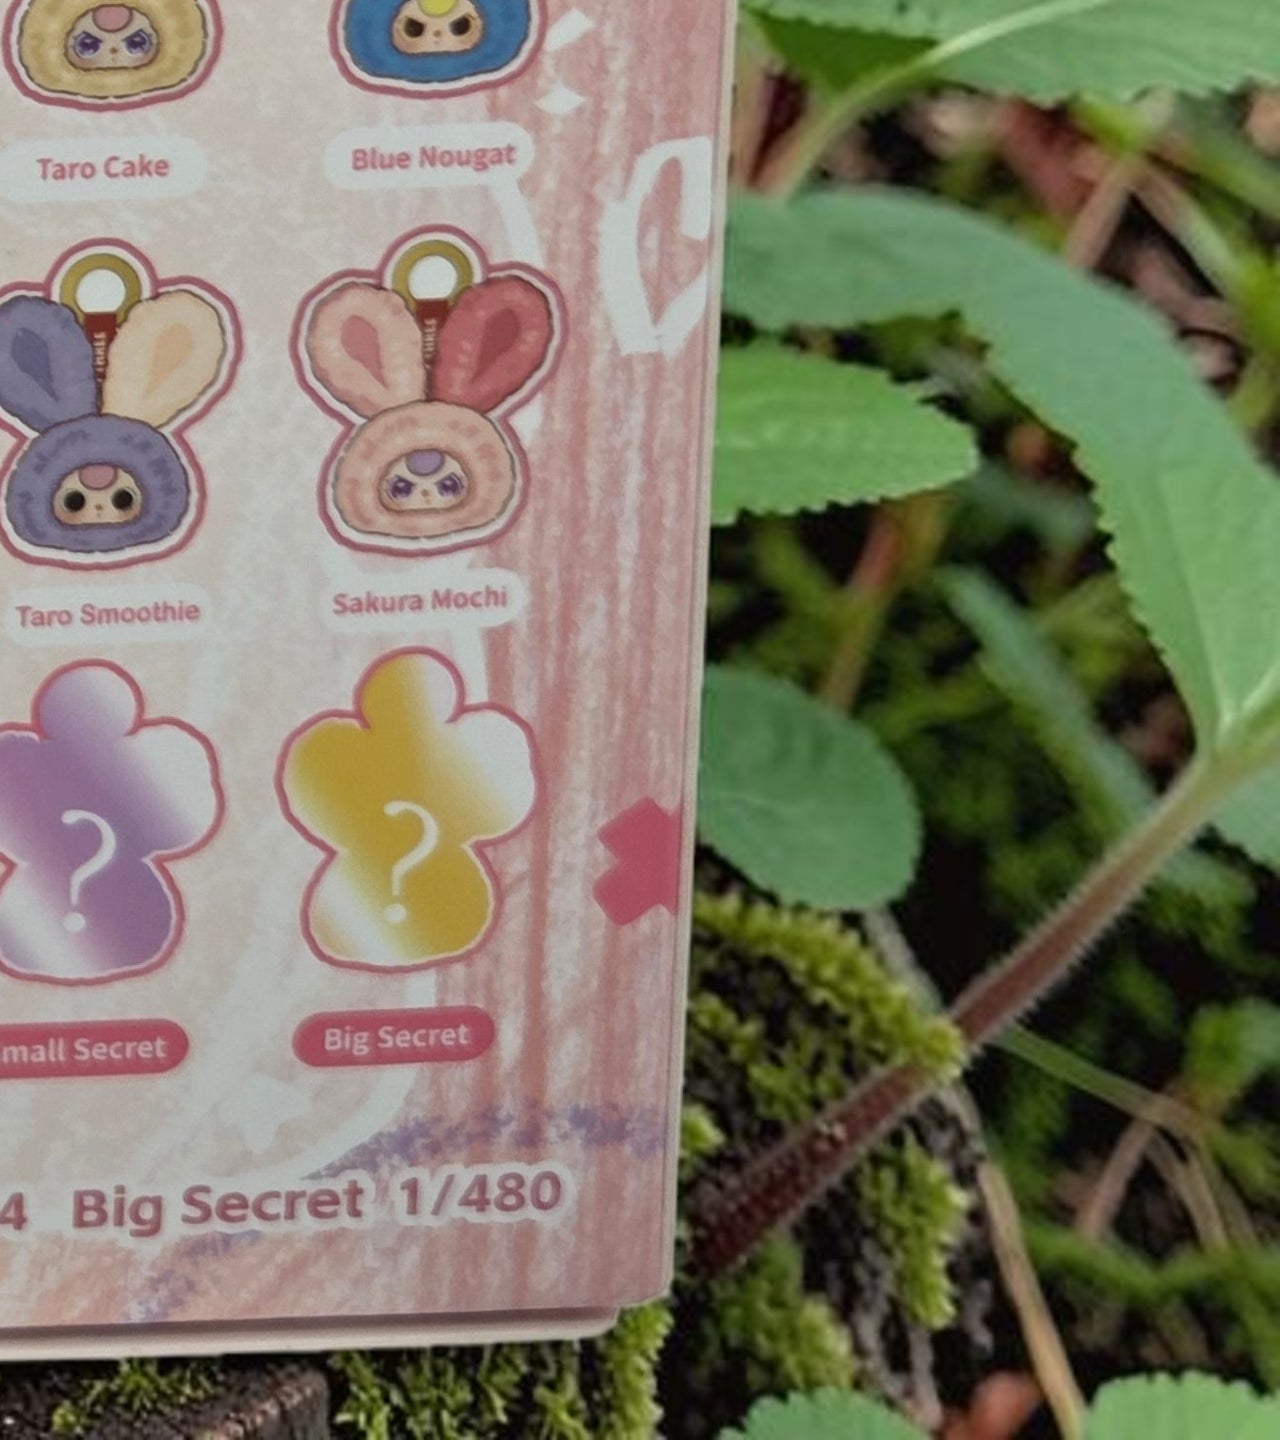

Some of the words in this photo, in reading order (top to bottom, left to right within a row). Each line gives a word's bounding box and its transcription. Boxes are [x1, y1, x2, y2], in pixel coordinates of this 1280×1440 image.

[35, 157, 97, 181] Taro
[102, 153, 171, 179] Cake
[351, 146, 412, 171] Blue
[419, 142, 517, 173] Nougat
[15, 605, 73, 629] Taro
[79, 599, 201, 625] Smoothie
[331, 589, 424, 616] Sakura
[430, 583, 509, 611] Mochi
[73, 1035, 167, 1061] Secret
[323, 1024, 370, 1057] Big
[377, 1023, 469, 1049] Secret
[70, 1183, 164, 1239] Big
[179, 1178, 365, 1226] Secret
[398, 1170, 563, 1218] 1/480
